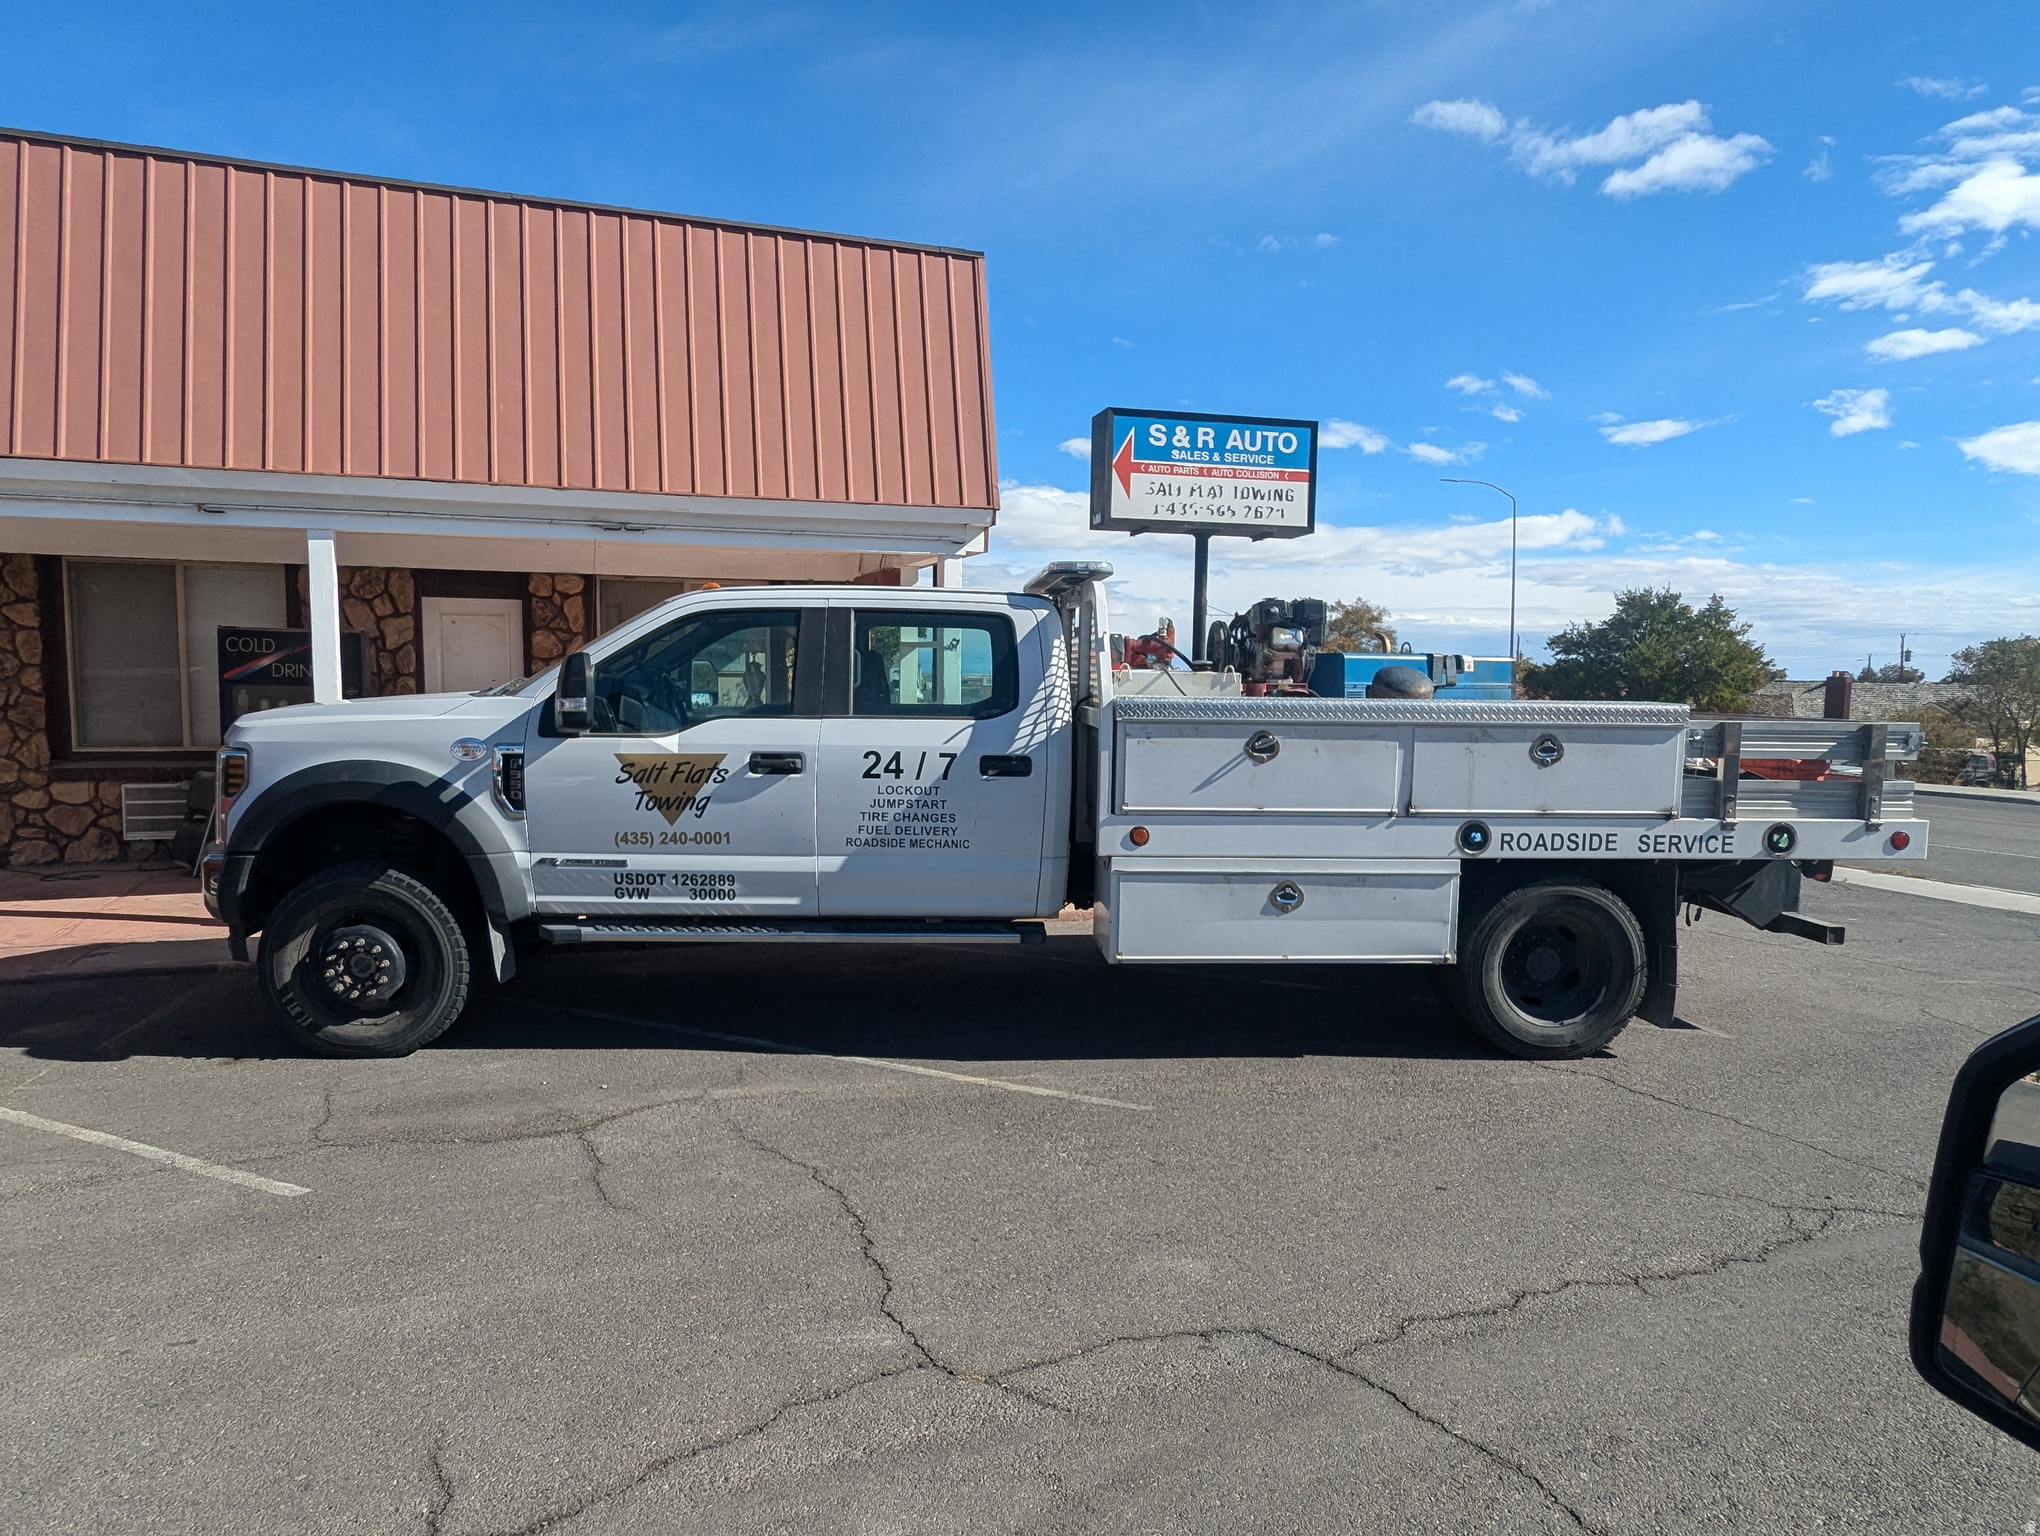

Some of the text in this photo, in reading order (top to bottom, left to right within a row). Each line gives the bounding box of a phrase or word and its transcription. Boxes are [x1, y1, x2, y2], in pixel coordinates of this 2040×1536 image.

[1149, 424, 1298, 454] S & R AUTO
[1171, 450, 1275, 465] SALES & SERVICE
[1148, 464, 1280, 480] AUTO PARTS AUTO COLLISION
[225, 637, 275, 653] COLD
[272, 663, 314, 678] DRIN
[615, 761, 729, 784] Salt Flats
[862, 750, 904, 780] 24
[939, 752, 958, 780] 7
[877, 785, 941, 796] LOCKOUT
[635, 790, 711, 818] Towing
[870, 799, 947, 810] JUMPSTART
[860, 812, 957, 823] TIRE CHANGES
[858, 825, 958, 836] FUEL DELIVERY
[614, 831, 731, 848] (435) 240-0001
[845, 838, 970, 849] ROADSIDE MECHANIC
[1500, 832, 1734, 854] ROADSIDE SERVICE
[614, 873, 736, 887] USDOT 1262889
[614, 887, 736, 901] GVW 30000
